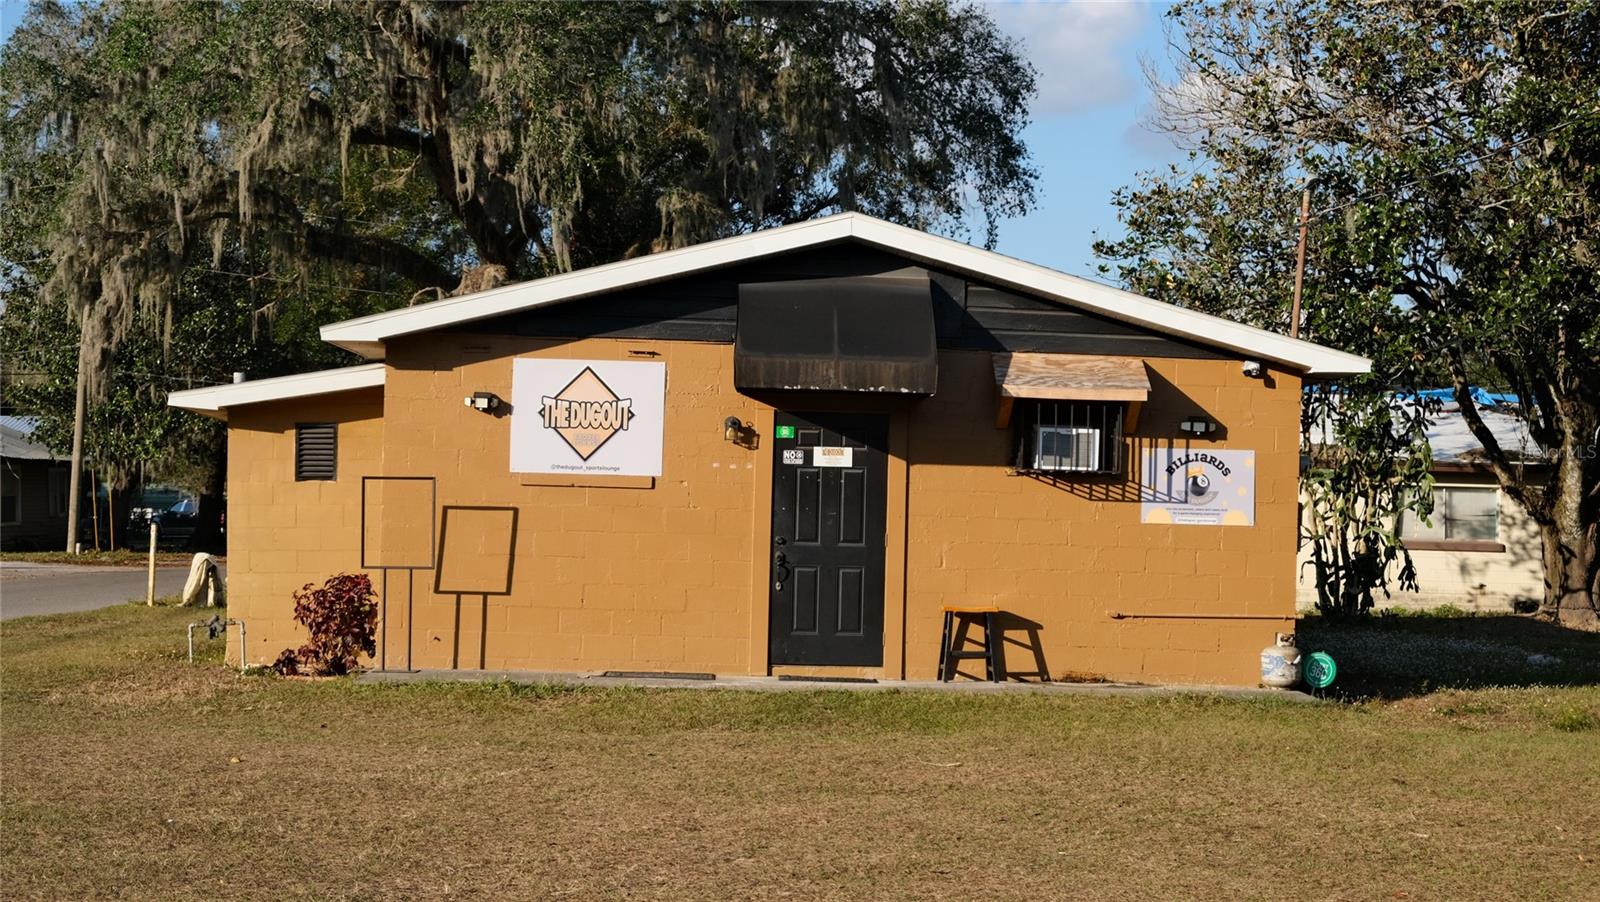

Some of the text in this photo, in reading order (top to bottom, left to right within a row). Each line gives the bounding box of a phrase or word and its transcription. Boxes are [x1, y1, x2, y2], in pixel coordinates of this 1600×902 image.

[542, 395, 632, 431] THE DUGOUT
[784, 450, 796, 459] NO
